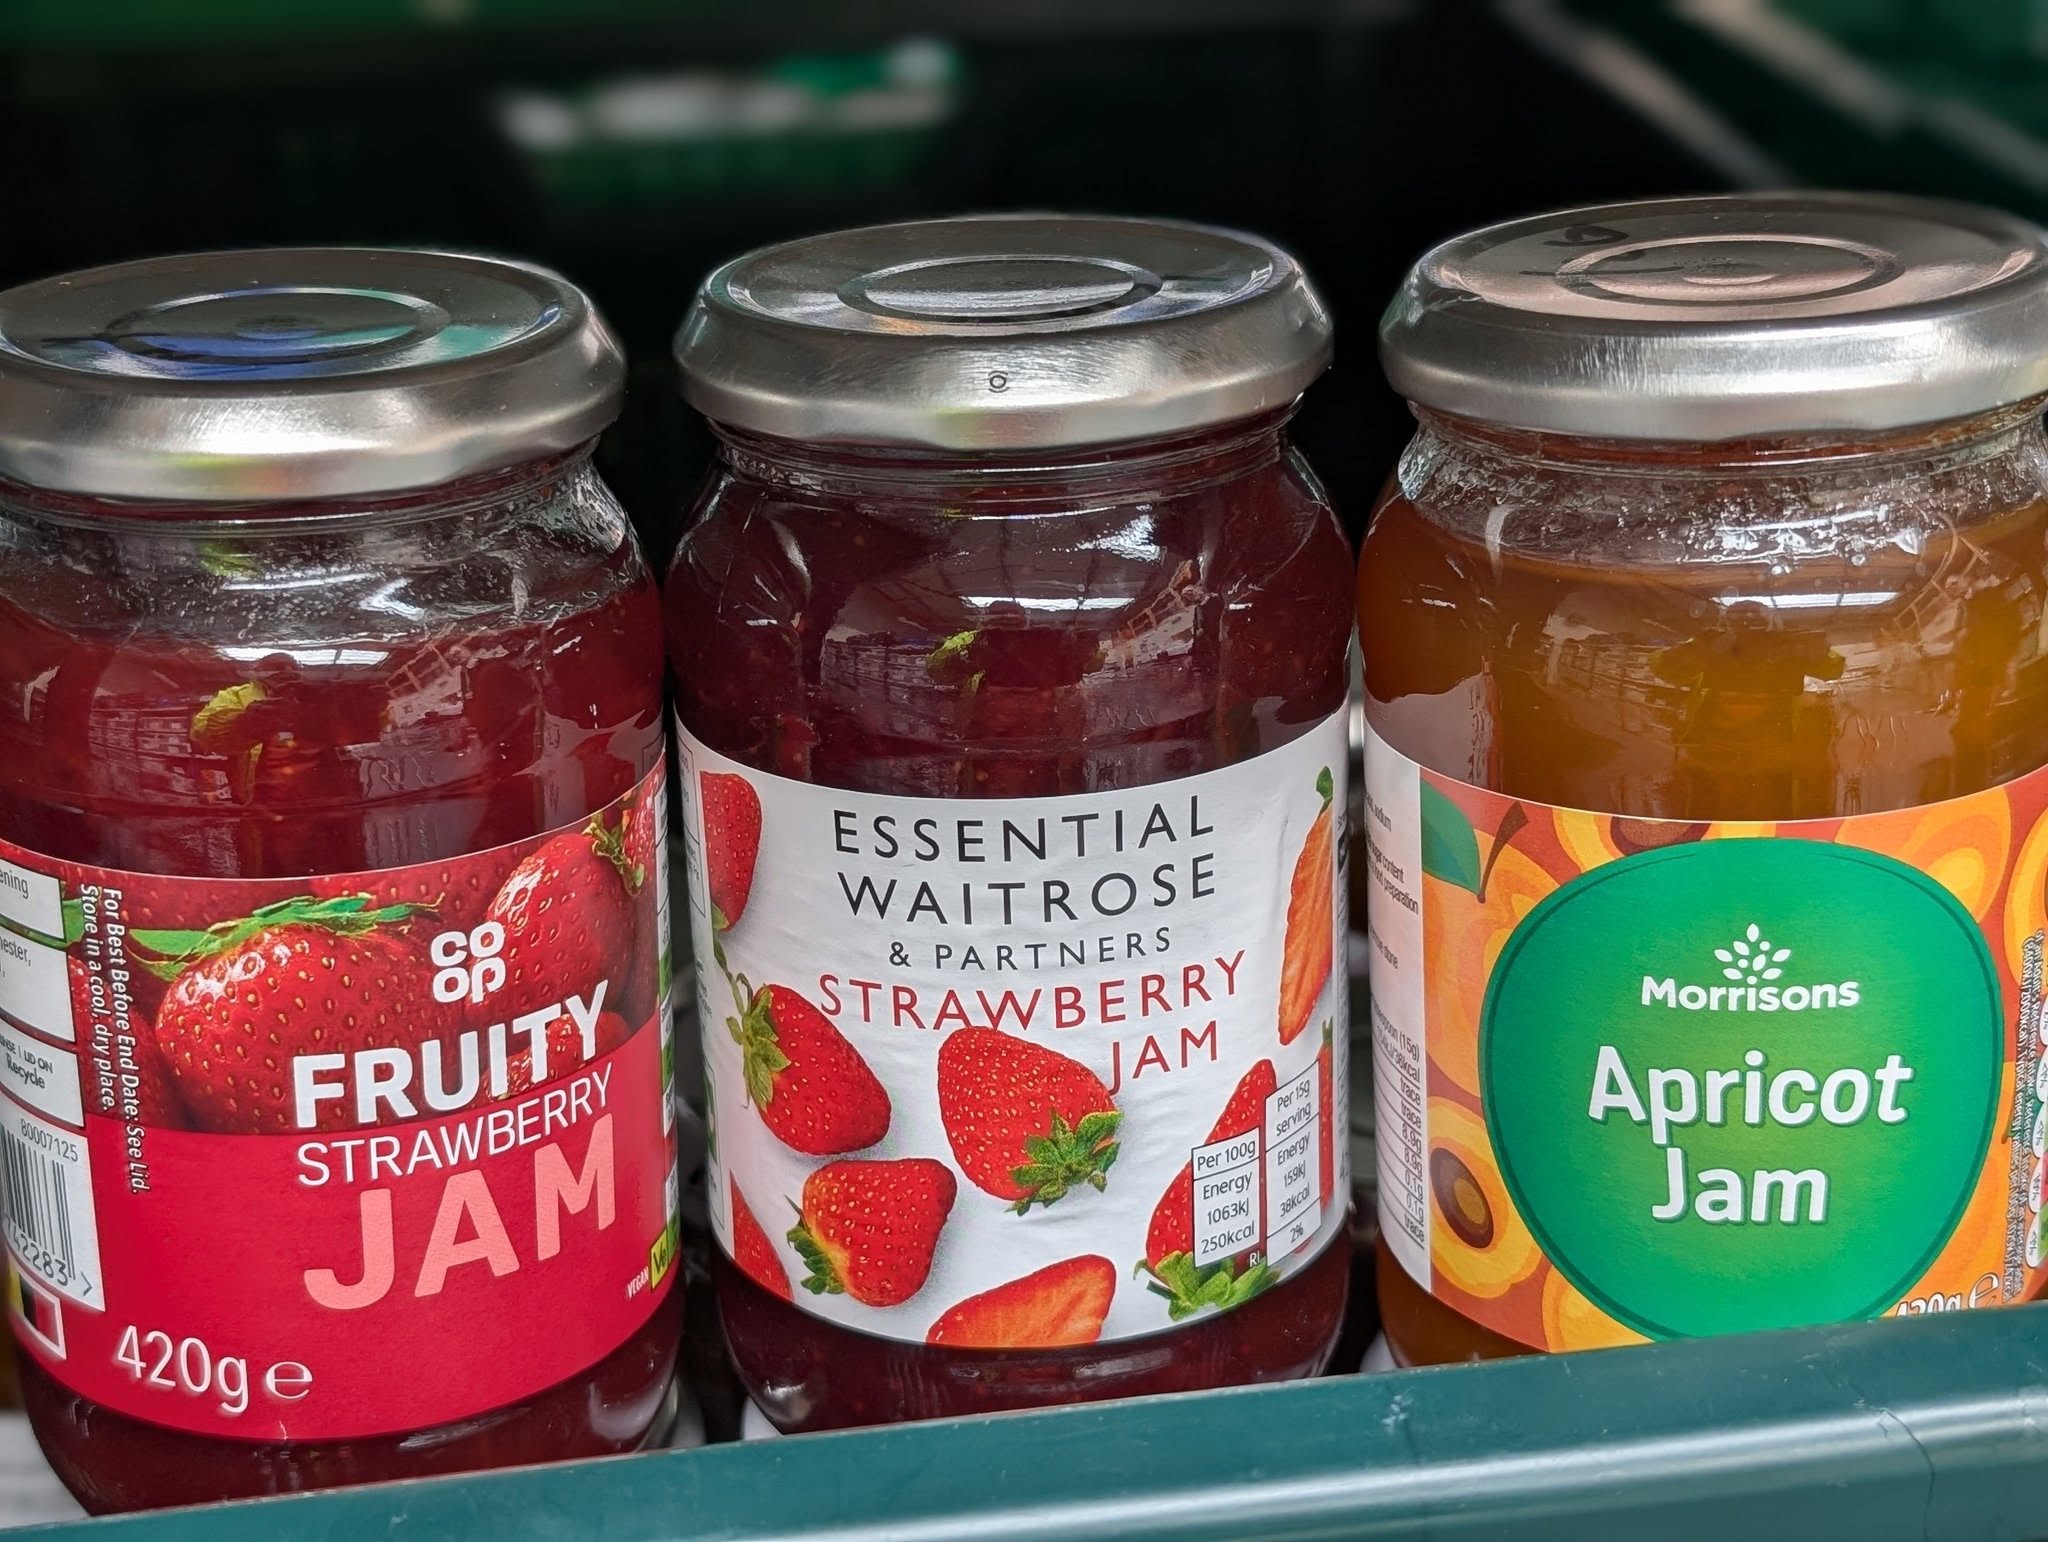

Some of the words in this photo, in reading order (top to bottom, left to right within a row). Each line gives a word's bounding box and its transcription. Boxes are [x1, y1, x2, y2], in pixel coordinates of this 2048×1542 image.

[833, 795, 1214, 863] ESSENTIAL
[104, 888, 122, 920] For
[837, 852, 1216, 926] WAITROSE
[80, 883, 99, 934] Store
[86, 938, 104, 957] in
[107, 923, 127, 966] Best
[889, 941, 912, 968] &
[935, 927, 1171, 971] PARTNERS
[88, 961, 102, 972] a
[90, 976, 112, 1018] cool,
[111, 968, 134, 1031] Before
[819, 949, 1246, 1032] STRAWBERRY
[1641, 975, 1861, 1012] Morrisons
[92, 1023, 114, 1055] dry
[117, 1034, 140, 1071] End
[293, 979, 610, 1129] FRUITY
[1399, 1030, 1420, 1063] (15g)
[6, 1051, 46, 1089] Recycle
[37, 1057, 54, 1074] ON
[1108, 1020, 1218, 1097] JAM
[93, 1057, 118, 1111] place.
[121, 1073, 140, 1121] Date:
[1277, 1094, 1294, 1113] Per
[1294, 1078, 1311, 1100] 15g
[1400, 1076, 1421, 1107] trace
[1588, 1045, 1915, 1146] Apricot
[298, 1061, 614, 1188] STRAWBERRY
[1276, 1101, 1312, 1138] serving
[1400, 1099, 1422, 1130] trace
[20, 1118, 79, 1163] 80007125
[127, 1125, 146, 1159] See
[1197, 1151, 1222, 1172] Per
[1225, 1138, 1257, 1164] 100g
[1277, 1131, 1311, 1166] Energy
[128, 1161, 150, 1194] Lid.
[1202, 1172, 1254, 1201] Energy
[1652, 1147, 1828, 1223] Jam
[303, 1111, 617, 1310] JAM
[1279, 1182, 1311, 1218] 38kcal
[1201, 1220, 1255, 1255] 250kcal
[1289, 1221, 1305, 1244] 2%
[1404, 1212, 1425, 1243] trace
[1249, 1250, 1261, 1268] RI
[627, 1265, 650, 1300] VEGAN
[115, 1324, 249, 1414] 420g
